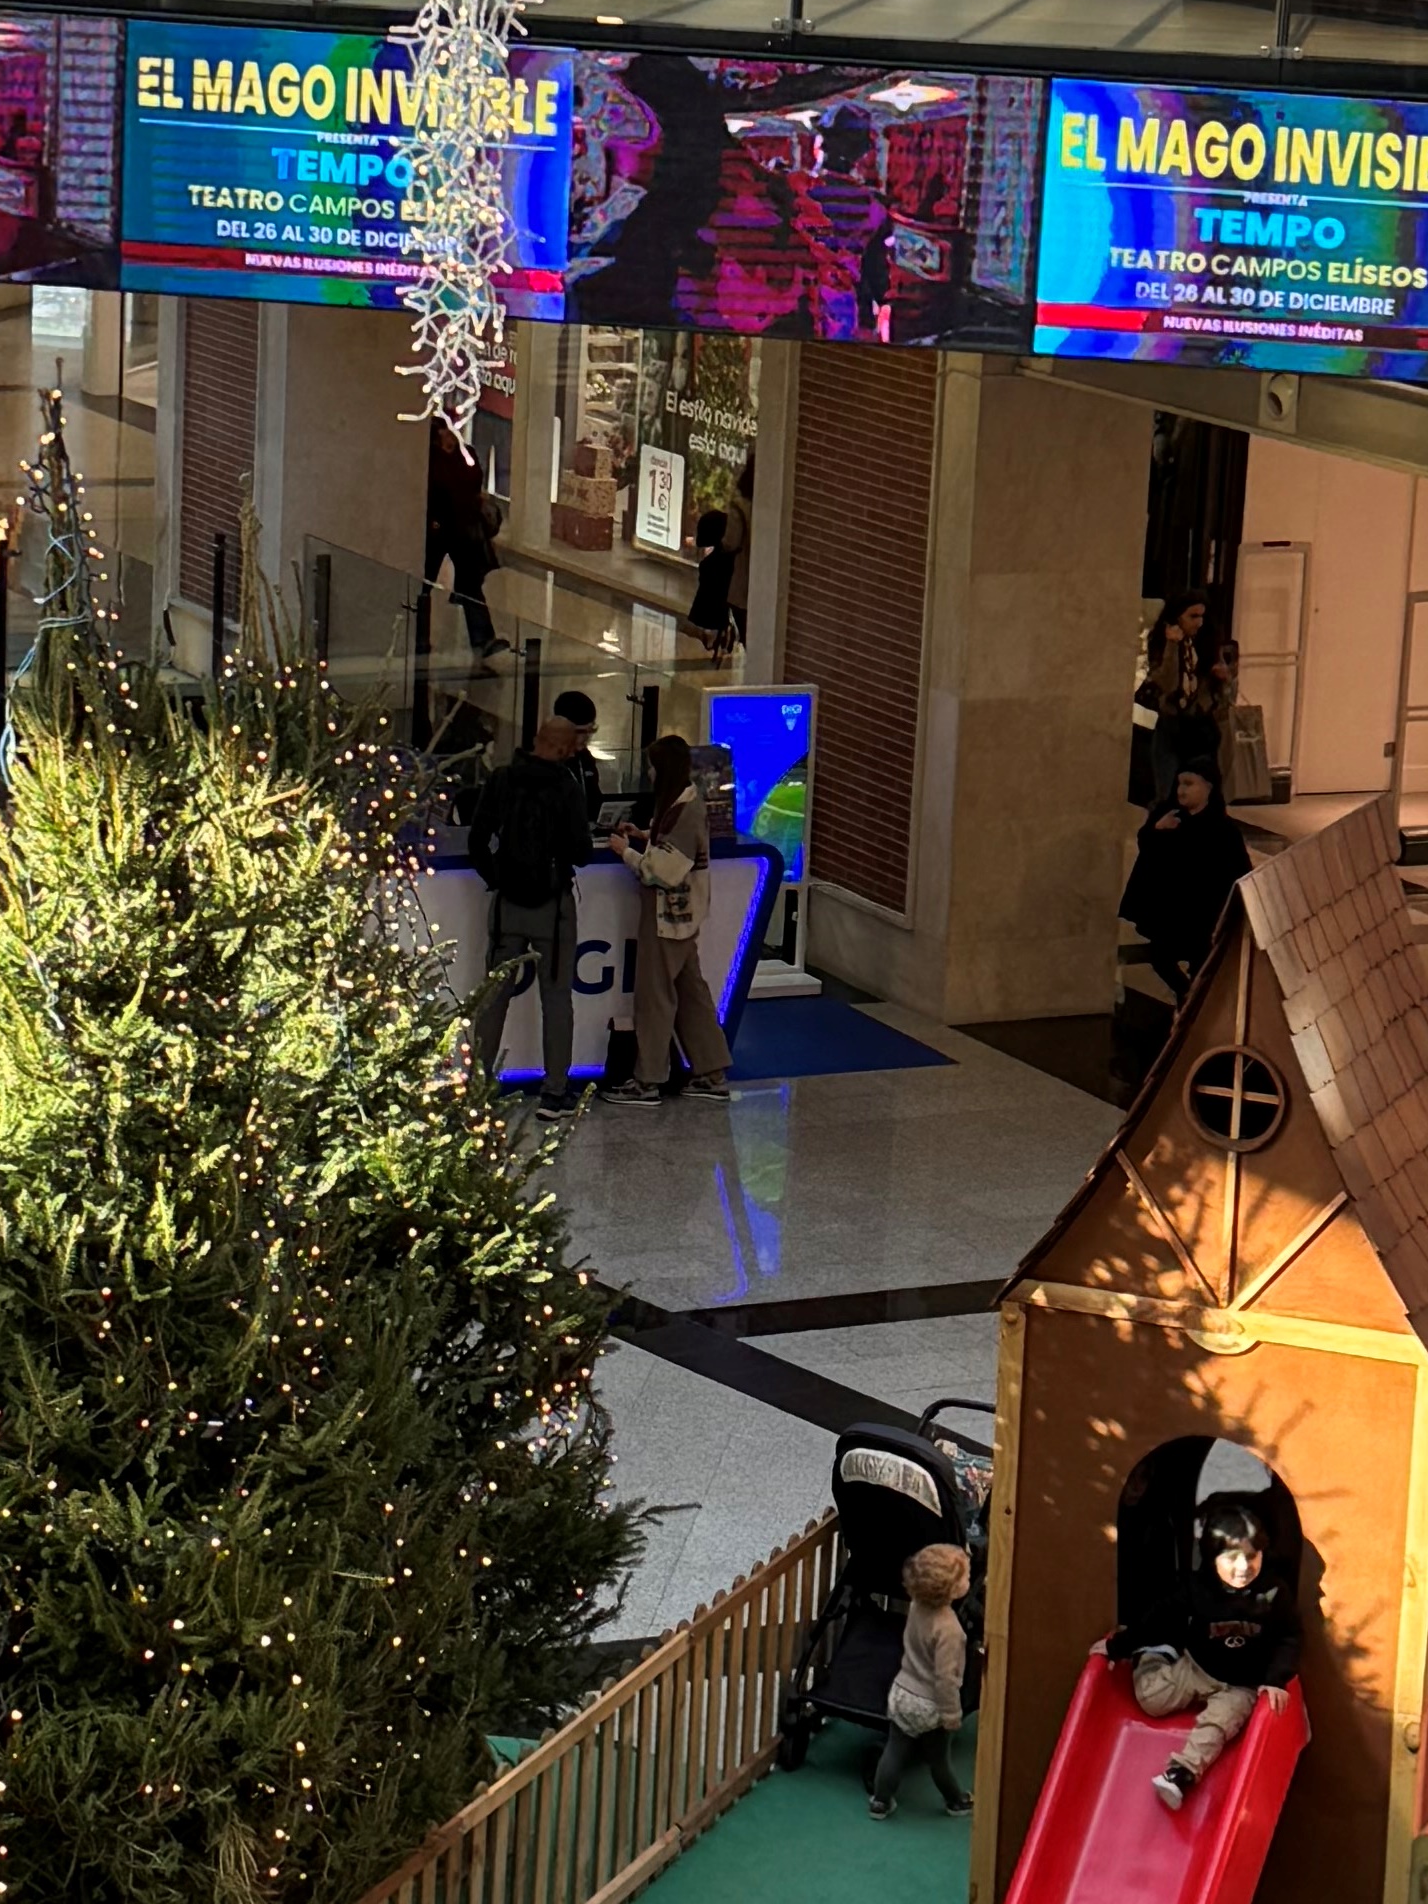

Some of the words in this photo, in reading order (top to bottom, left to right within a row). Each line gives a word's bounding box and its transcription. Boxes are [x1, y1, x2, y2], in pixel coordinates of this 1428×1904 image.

[138, 57, 184, 109] EL
[192, 59, 336, 121] MAGO
[317, 131, 379, 146] PRESENTA
[1061, 113, 1106, 171] EL
[1117, 117, 1266, 181] MAGO
[272, 147, 414, 188] TEMPO
[188, 184, 283, 211] TEATRO
[289, 194, 395, 219] CAMPOS
[217, 220, 250, 238] DEL
[254, 222, 276, 240] 26
[281, 224, 304, 242] AL
[309, 225, 333, 244] 30
[337, 227, 360, 246] DE
[1194, 207, 1346, 249] TEMPO
[245, 253, 301, 269] NUEVAS
[1110, 246, 1206, 273] TEATRO
[1211, 255, 1321, 281] CAMPOS
[1327, 258, 1428, 289] ELÍSEOS
[1136, 282, 1170, 300] DEL
[1174, 283, 1198, 302] 26
[1201, 285, 1226, 304] AL
[1230, 286, 1255, 306] 30
[1259, 289, 1285, 308] DE
[1290, 292, 1395, 317] DICIEMBRE
[1163, 316, 1221, 332] NUEVAS
[1223, 318, 1296, 337] ILUSIONES
[1298, 321, 1364, 342] INÉDITAS
[666, 390, 678, 413] El
